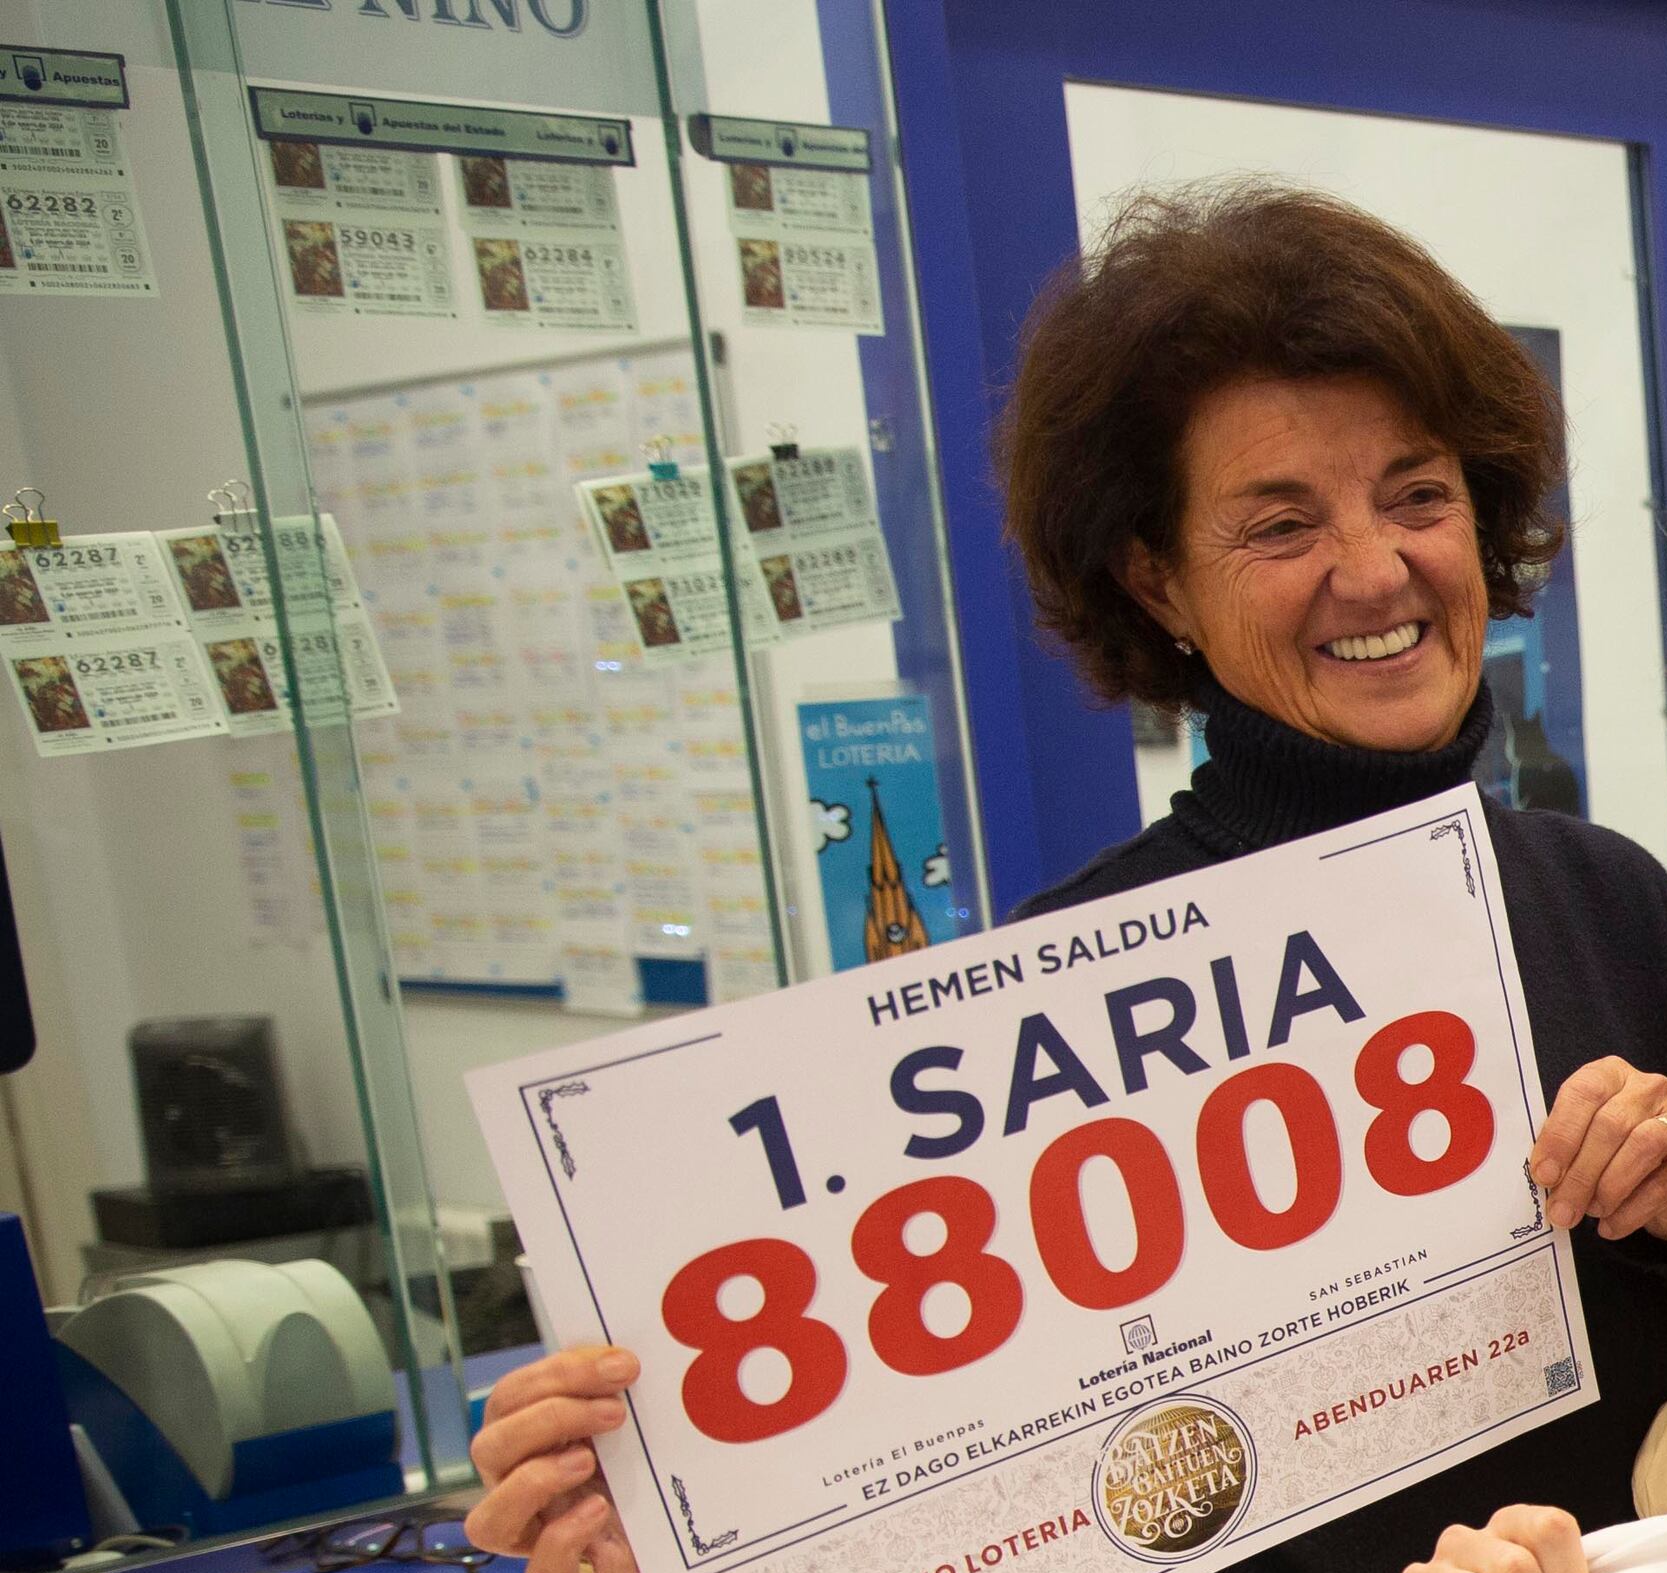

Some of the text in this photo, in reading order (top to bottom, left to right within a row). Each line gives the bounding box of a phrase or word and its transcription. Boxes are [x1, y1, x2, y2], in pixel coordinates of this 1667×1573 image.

[52, 70, 121, 87] Apuestas
[7, 193, 97, 215] 62282
[339, 228, 417, 250] 59043
[35, 547, 118, 568] 62287
[76, 652, 160, 675] 62287
[867, 901, 1210, 1027] HEMEN SALDUA
[728, 929, 1367, 1211] 1. SARIA
[662, 1010, 1498, 1446] 88008
[1308, 1249, 1429, 1301] SAN SEBASTIAN
[862, 1278, 1411, 1501] EZ DAGO ELKARREKIN EGOTEA BAINO ZORTE HOBERIK
[1078, 1329, 1214, 1391] Lotería Nacional
[1293, 1330, 1531, 1441] ABENDUAREN 22a
[822, 1418, 986, 1488] Lotería El Buenpas
[1102, 1415, 1219, 1490] BATZEN
[1110, 1464, 1240, 1544] ZOZKETA
